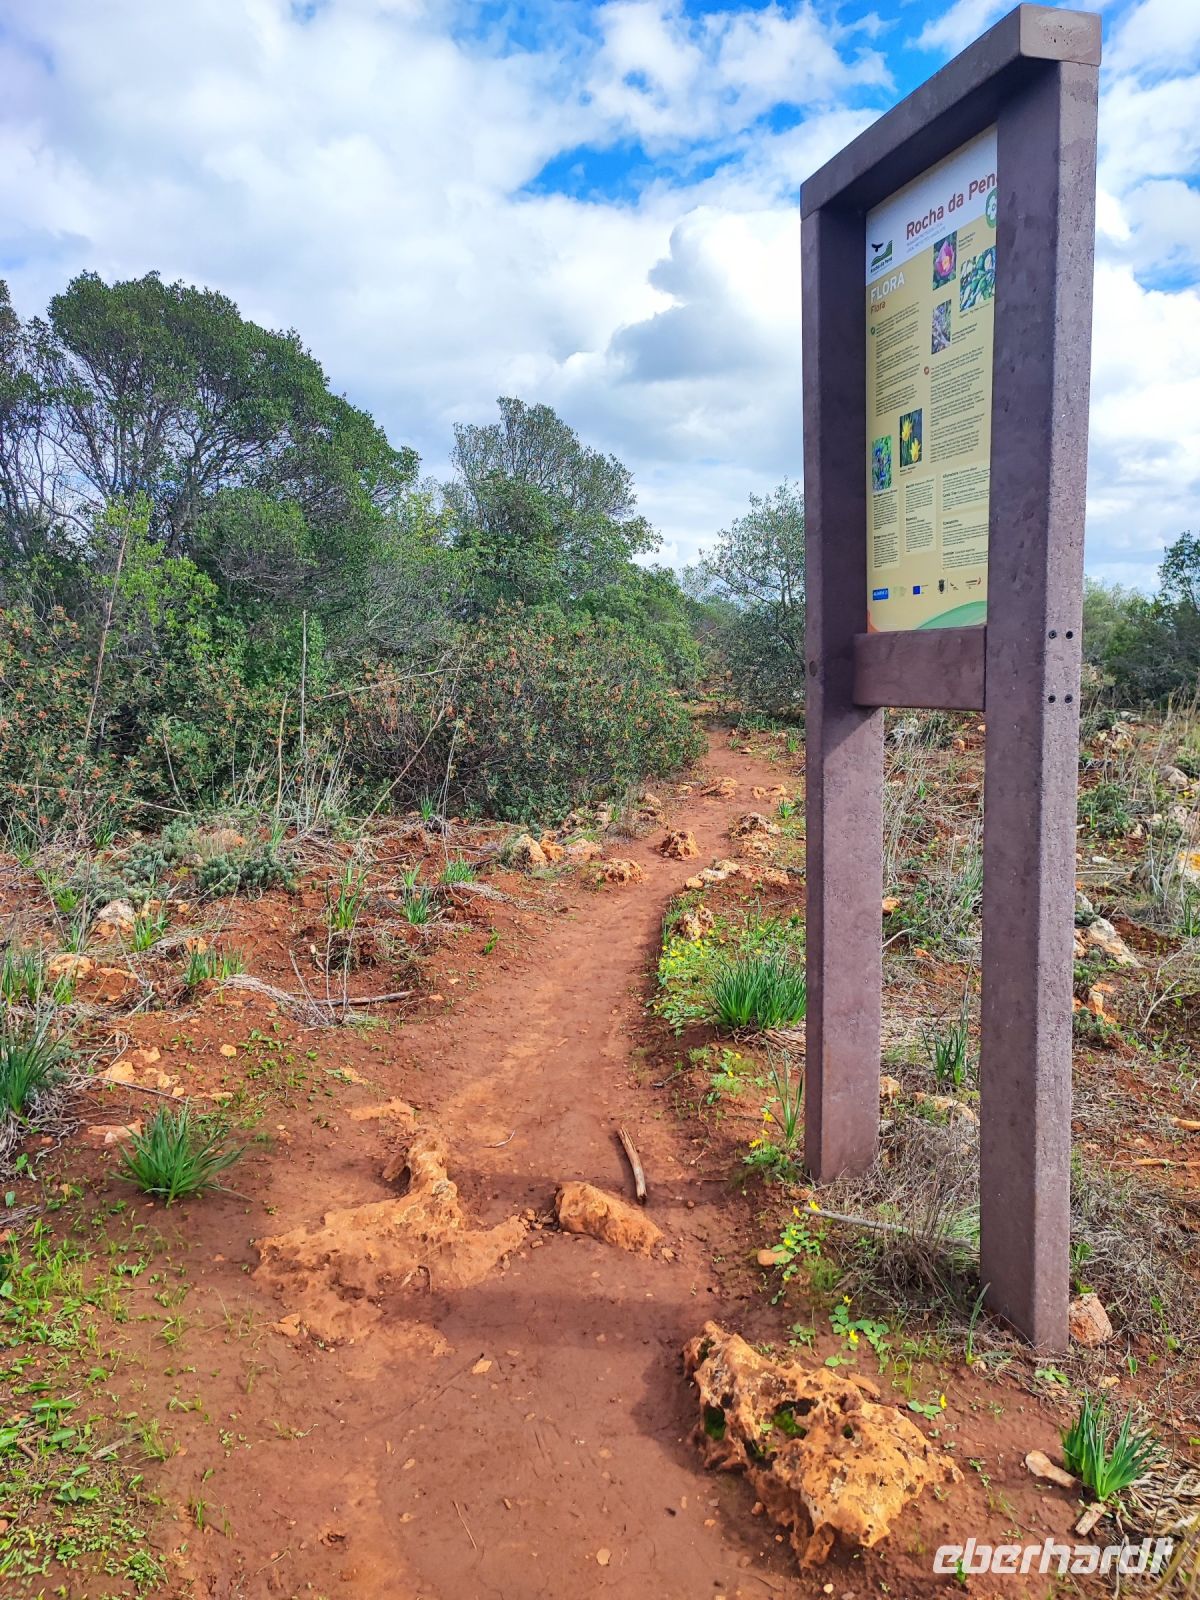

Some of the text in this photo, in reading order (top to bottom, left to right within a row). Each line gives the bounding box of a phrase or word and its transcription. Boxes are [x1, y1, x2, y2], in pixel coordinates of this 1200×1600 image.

[906, 205, 944, 240] Rocha
[948, 192, 964, 213] da
[968, 172, 997, 200] Pen
[870, 271, 905, 303] FLORA
[870, 301, 886, 314] Flora
